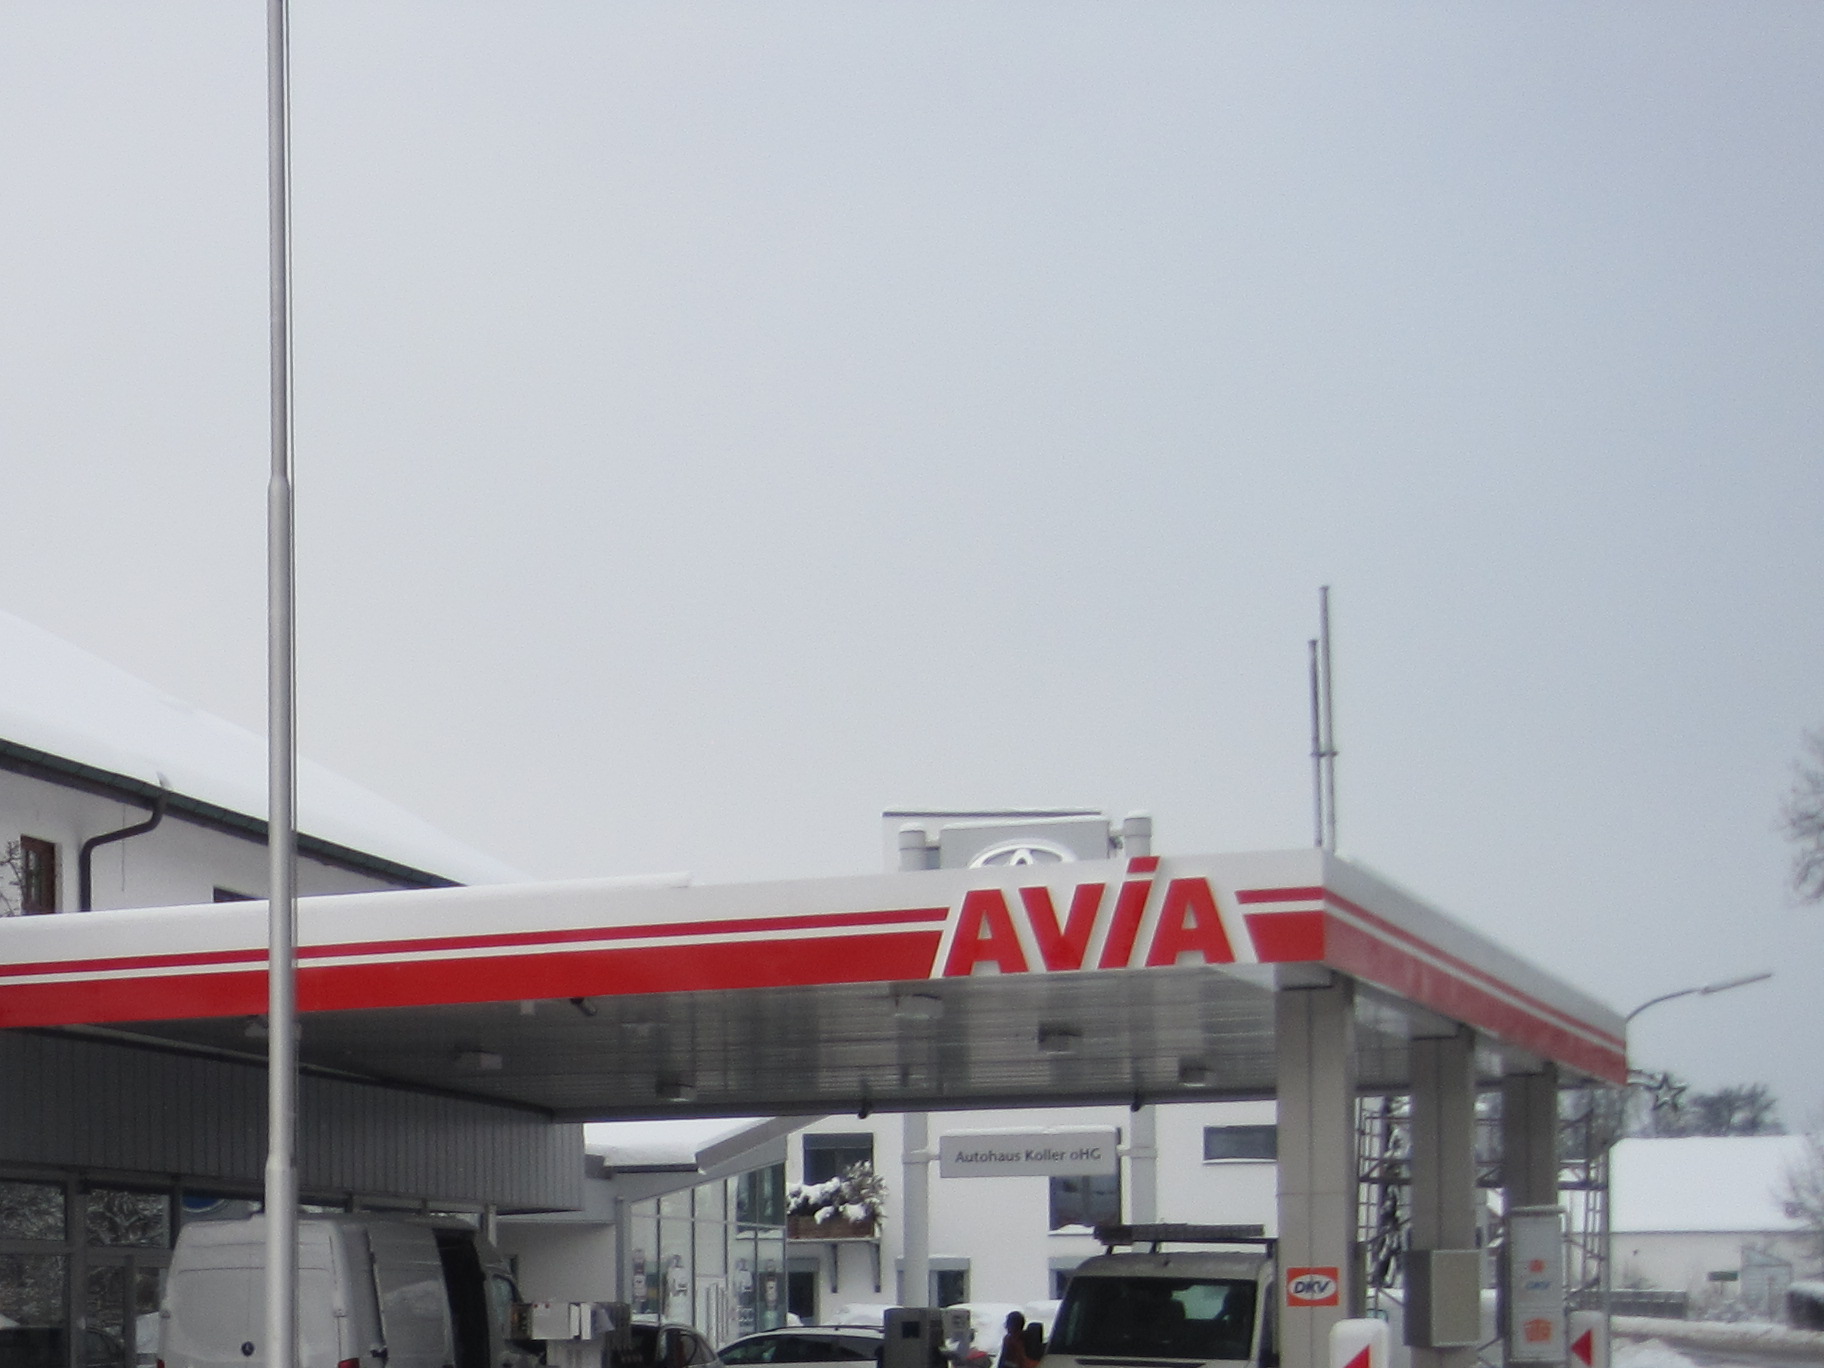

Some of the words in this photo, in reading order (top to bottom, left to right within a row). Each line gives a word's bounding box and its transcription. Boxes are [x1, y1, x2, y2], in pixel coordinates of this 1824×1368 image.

[943, 856, 1235, 977] AVIA
[955, 1150, 1021, 1163] Autohaus
[1026, 1147, 1065, 1162] Koller
